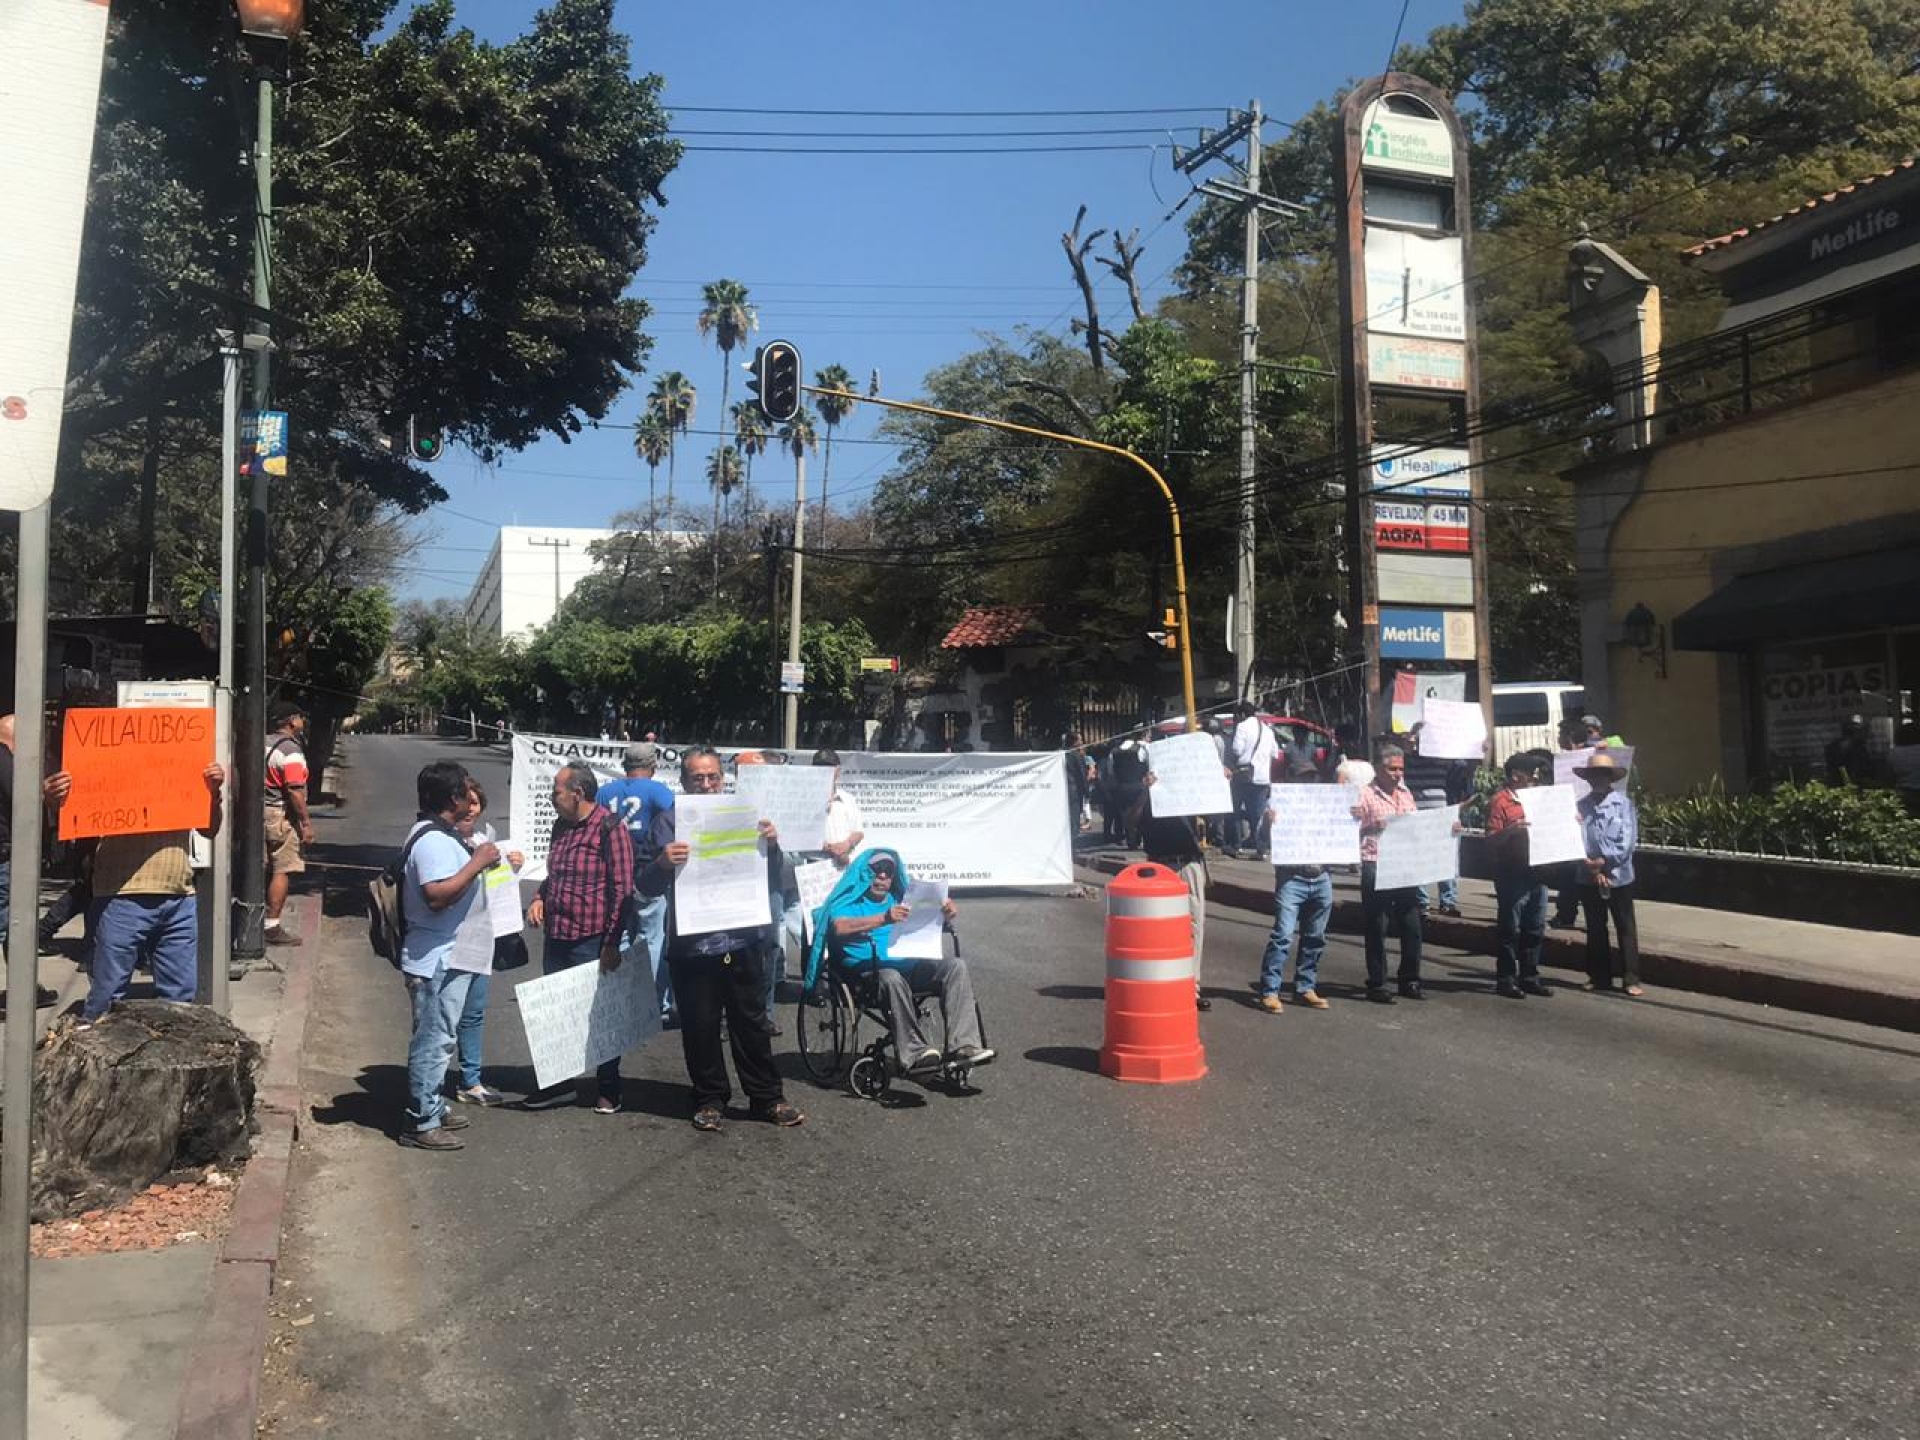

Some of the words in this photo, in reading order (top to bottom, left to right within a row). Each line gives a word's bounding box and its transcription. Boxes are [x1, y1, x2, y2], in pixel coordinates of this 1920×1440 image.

[1810, 209, 1900, 260] MetLife
[1379, 527, 1423, 544] AGFA
[1382, 625, 1441, 643] MetLife
[1764, 667, 1882, 699] COPIAS
[70, 714, 206, 747] VILLALOBOS
[89, 808, 138, 830] ROBO
[608, 796, 642, 831] 12
[871, 821, 907, 829] MARZO
[909, 821, 924, 829] DE
